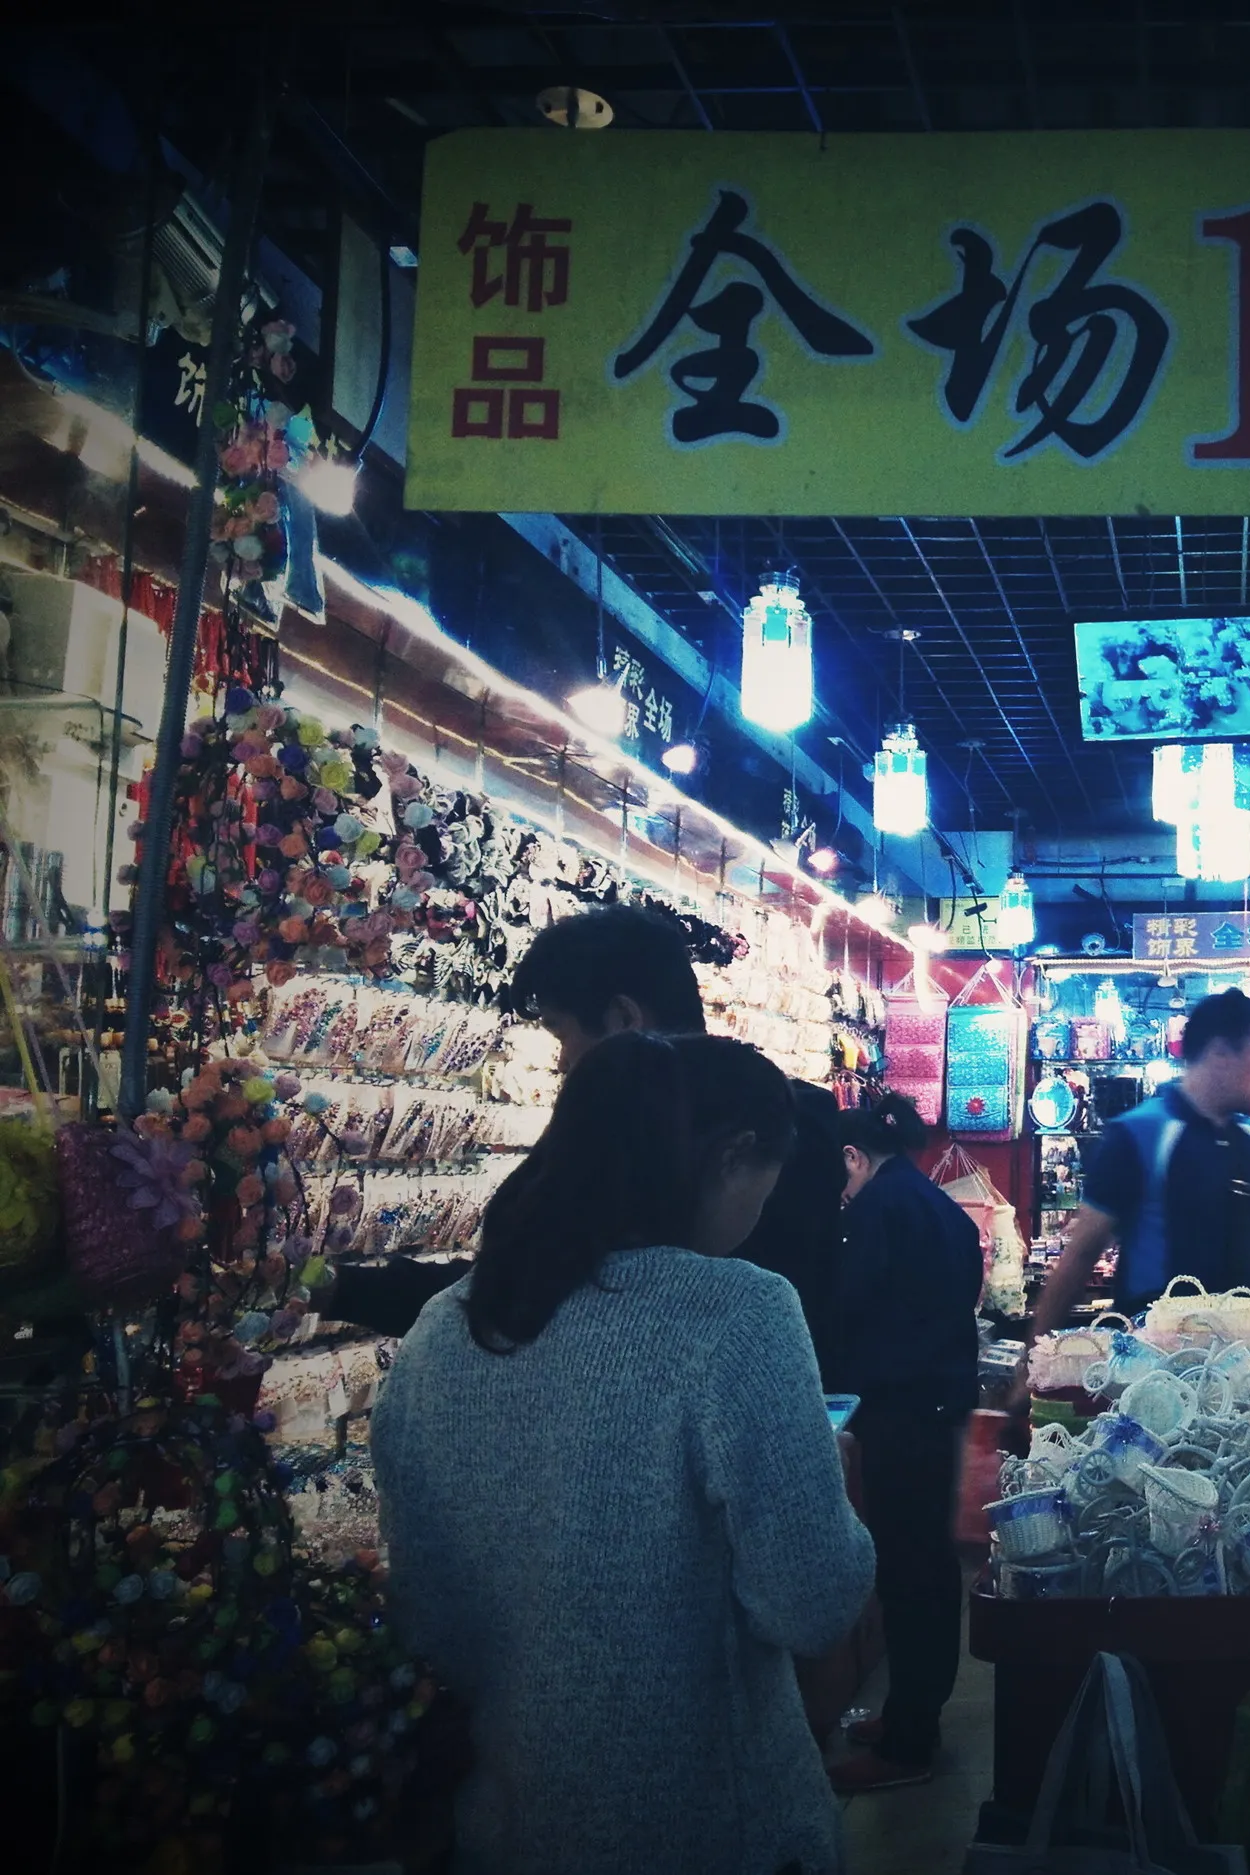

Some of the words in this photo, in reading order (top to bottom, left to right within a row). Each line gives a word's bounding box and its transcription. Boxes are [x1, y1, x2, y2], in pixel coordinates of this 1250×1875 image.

[452, 202, 572, 440] 饰品
[643, 687, 673, 743] 全场
[1146, 918, 1198, 937] 精彩
